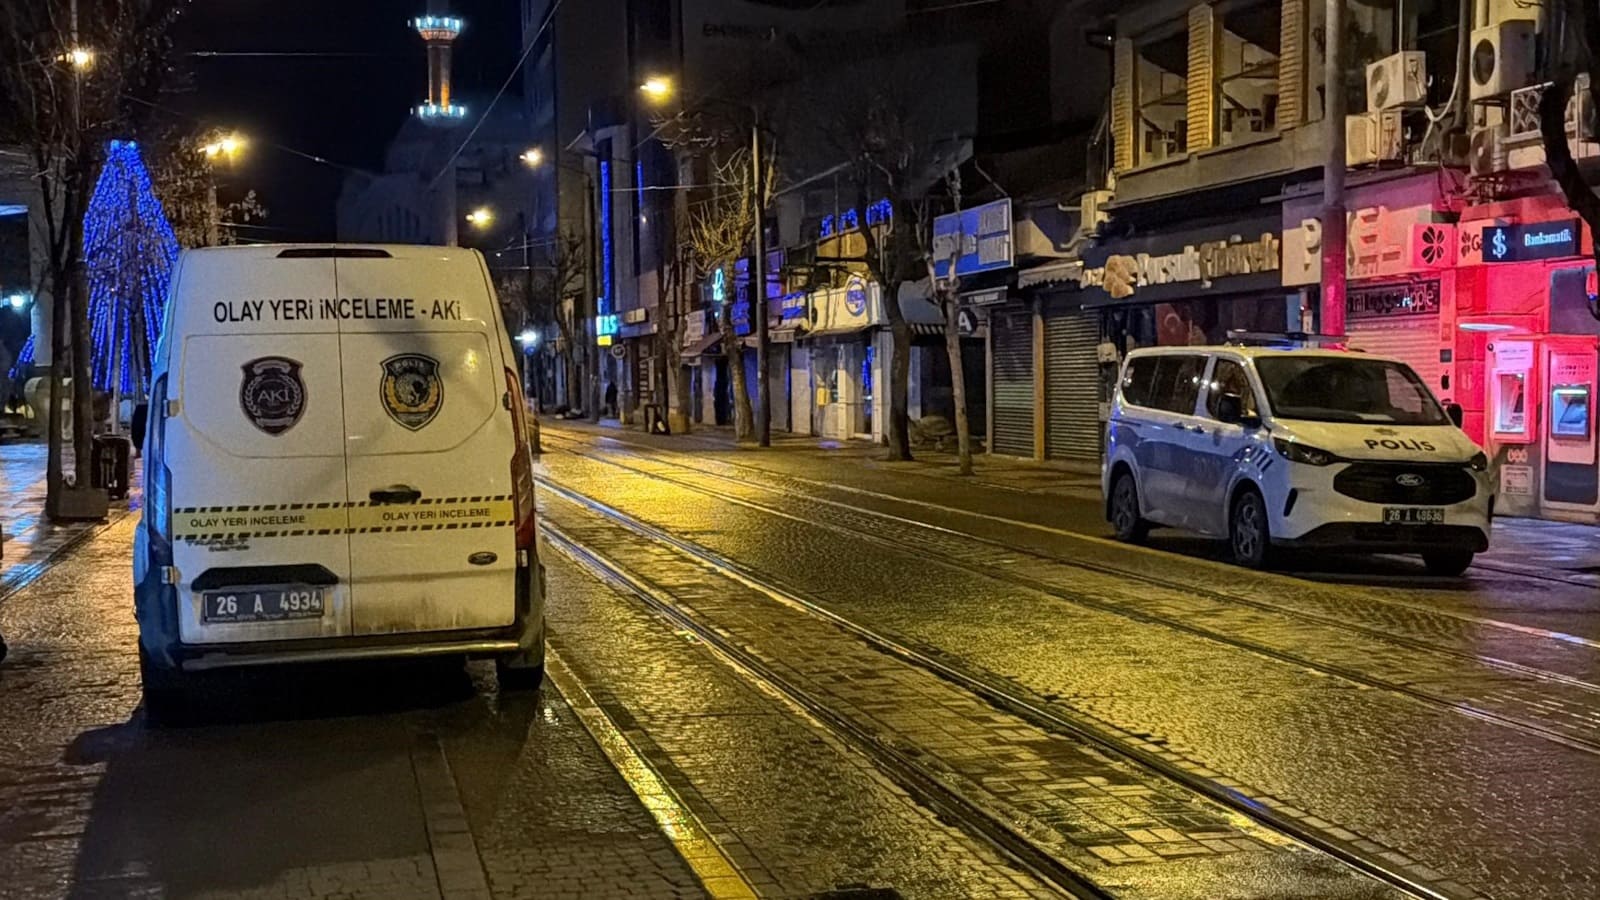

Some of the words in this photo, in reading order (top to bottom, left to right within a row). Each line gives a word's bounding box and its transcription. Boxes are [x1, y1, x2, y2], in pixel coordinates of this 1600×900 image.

[1524, 229, 1572, 247] Bankamatik
[1402, 283, 1434, 312] Apple
[213, 301, 264, 322] OLAY
[190, 518, 220, 528] OLAY
[382, 511, 411, 521] OLAY
[216, 596, 238, 615] 26
[254, 594, 264, 613] A
[279, 591, 321, 611] 4934
